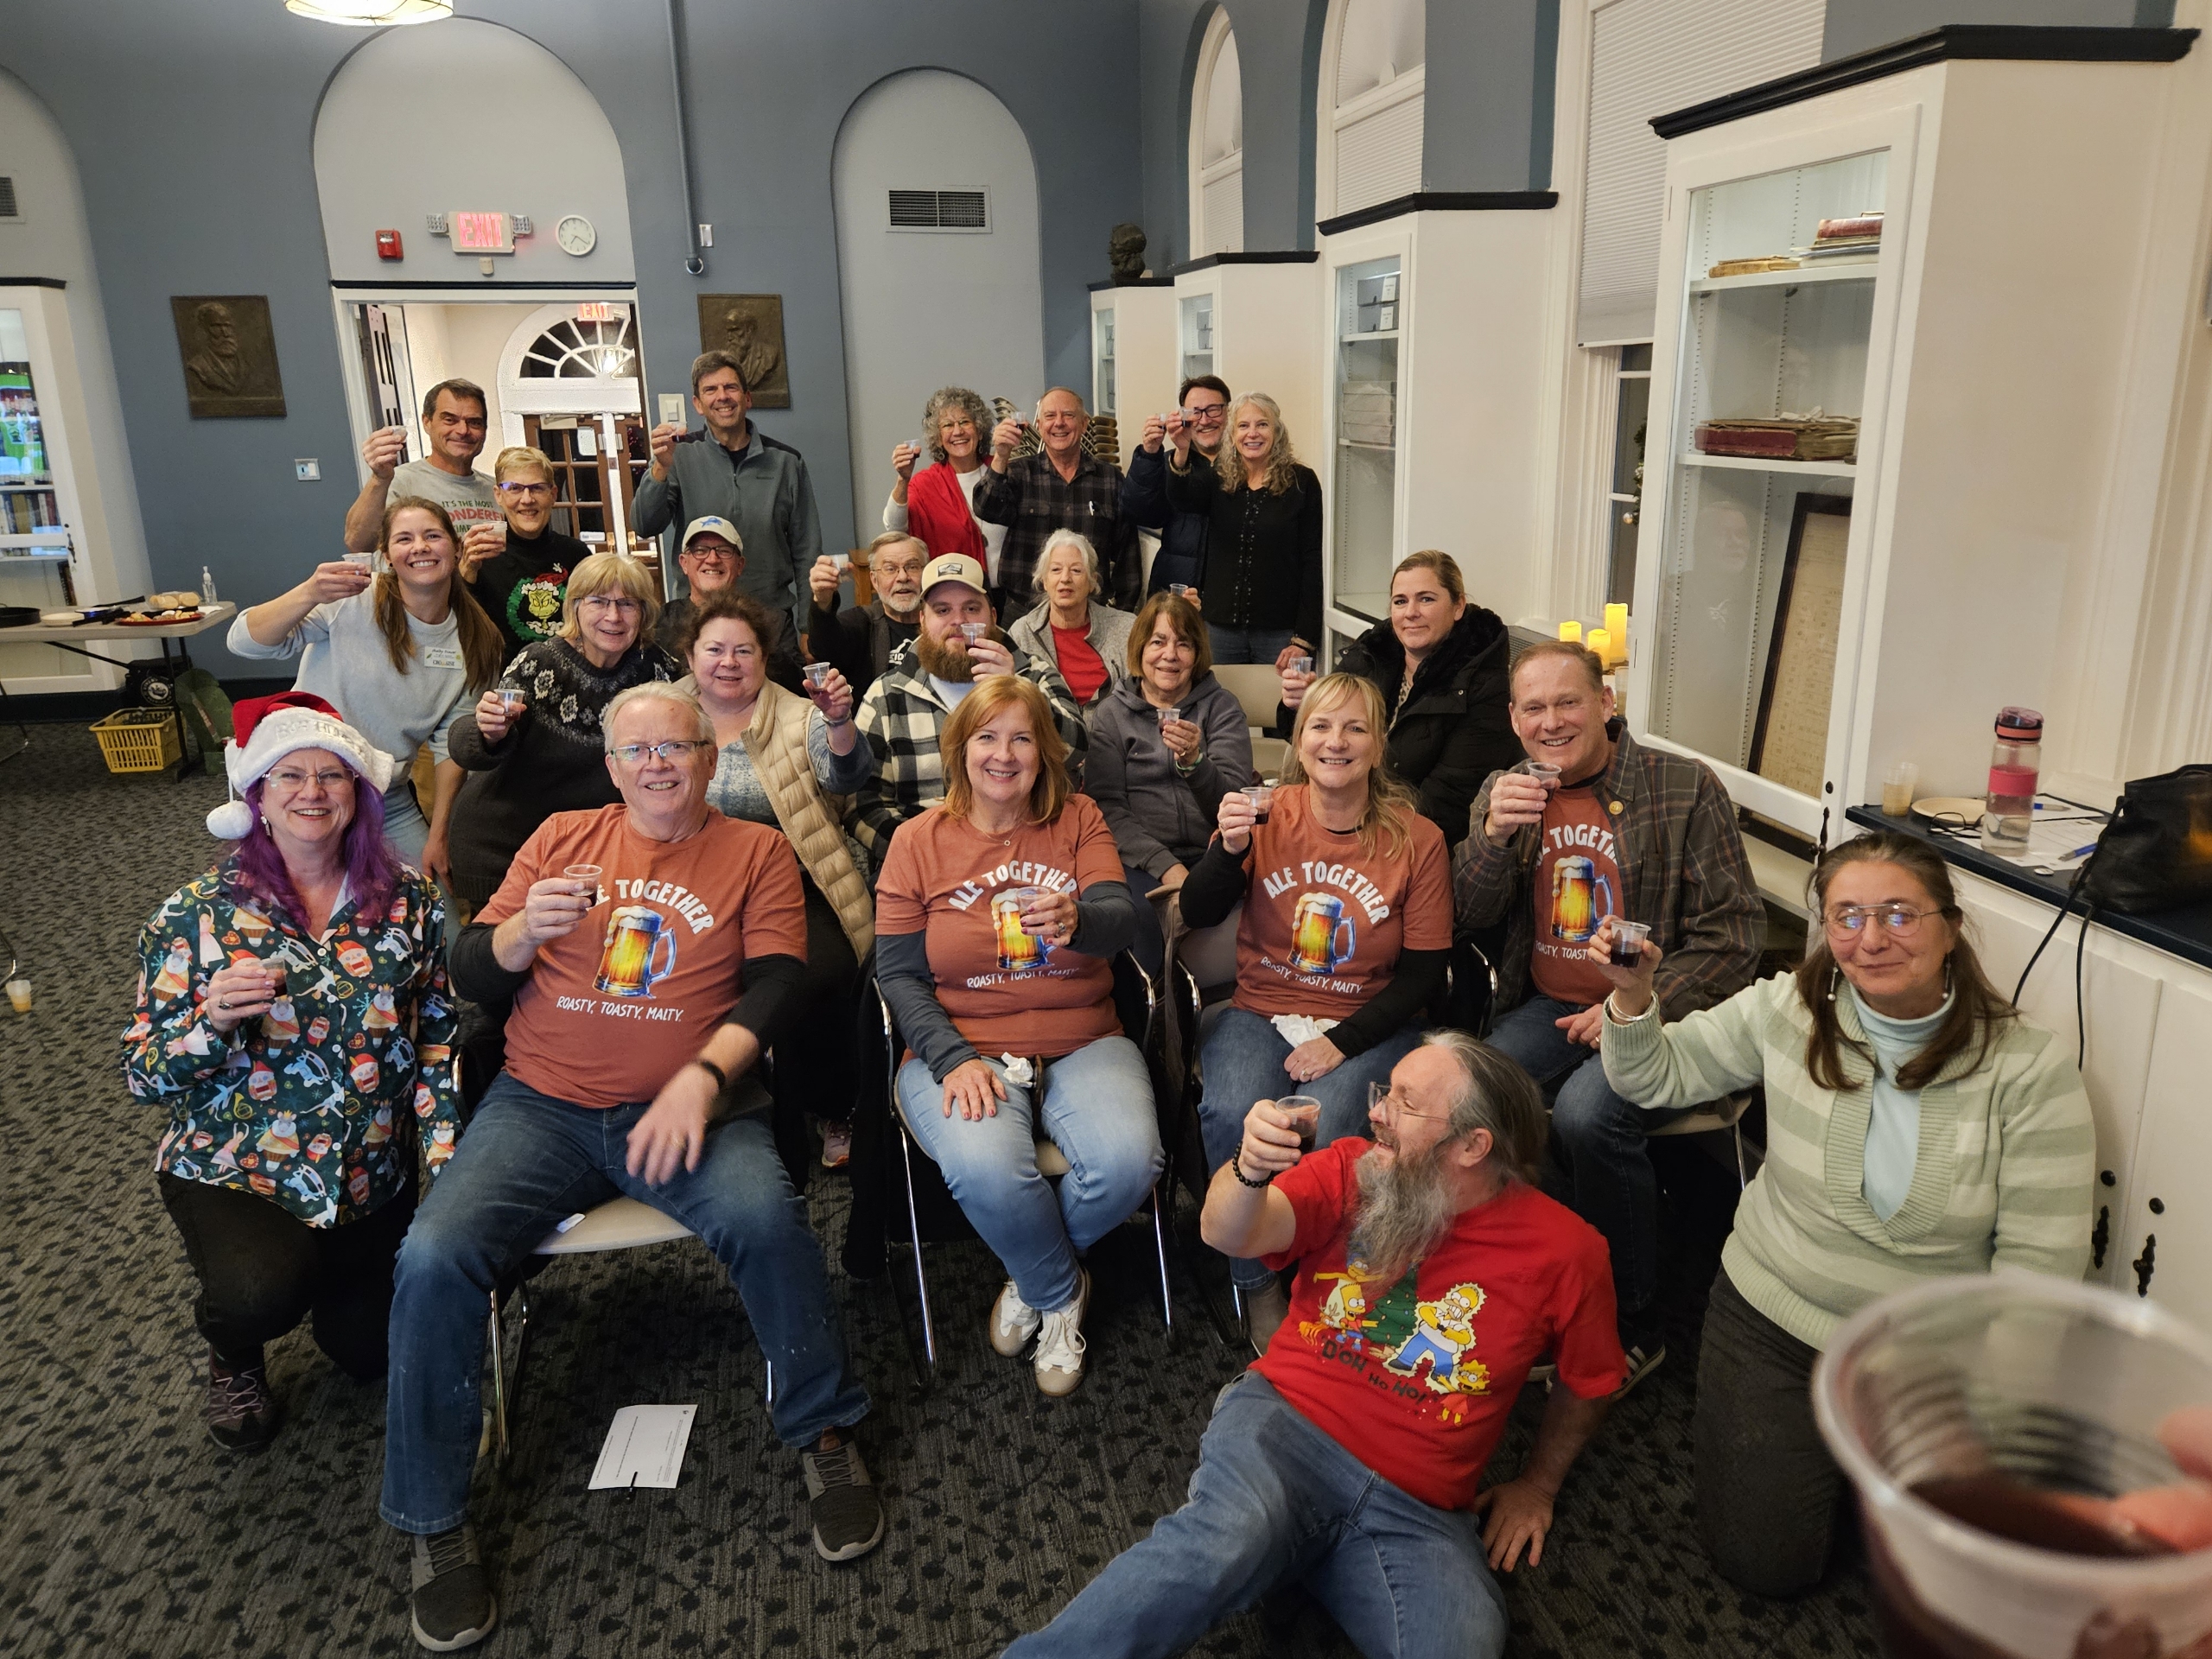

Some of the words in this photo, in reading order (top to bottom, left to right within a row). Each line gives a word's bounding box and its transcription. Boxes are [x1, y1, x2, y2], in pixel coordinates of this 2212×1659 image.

[457, 213, 503, 247] EXIT
[474, 499, 493, 508] MOST
[948, 880, 984, 911] ALE
[982, 860, 1077, 893] TOGETHER
[1262, 867, 1298, 899] ALE
[1301, 861, 1389, 925] TOGETHER
[615, 878, 715, 934] TOGETHER
[967, 973, 1005, 988] ROASTY,
[556, 996, 597, 1014] ROASTY,
[601, 1001, 644, 1020] TOASTY,
